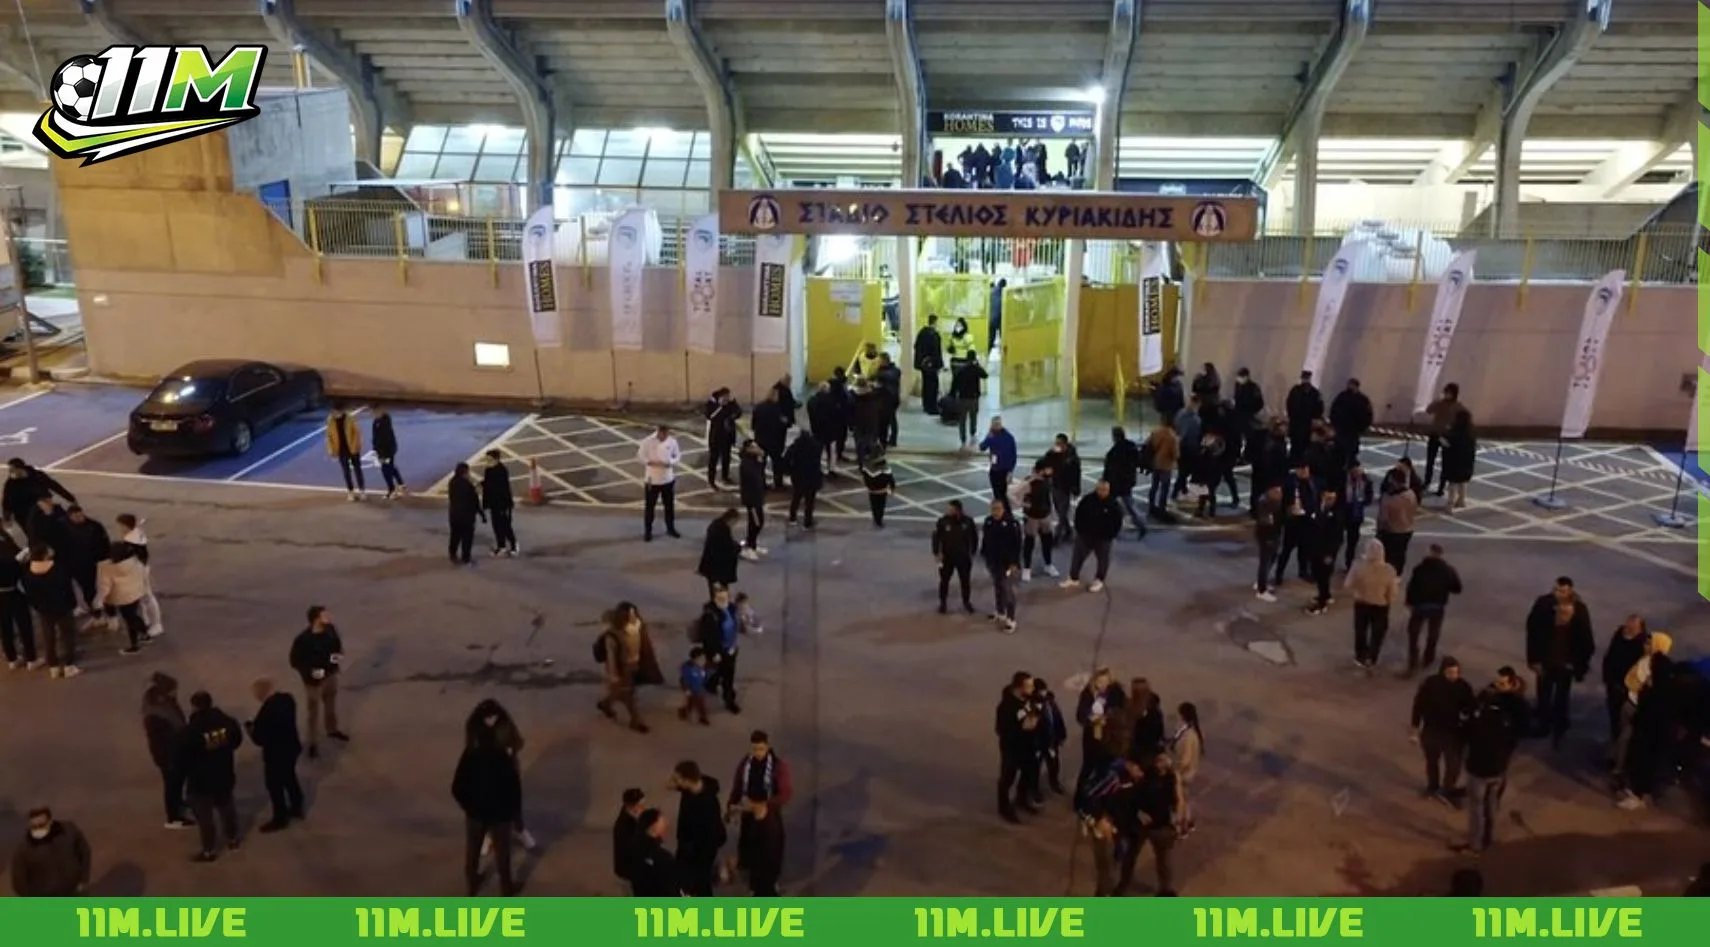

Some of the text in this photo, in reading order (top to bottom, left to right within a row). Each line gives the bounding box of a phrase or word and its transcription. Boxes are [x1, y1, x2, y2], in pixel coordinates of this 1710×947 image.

[944, 119, 994, 132] HOMES
[1025, 206, 1173, 230] ΚΥΡΙΑΚΙΔΗΣ
[769, 265, 783, 314] HOMES
